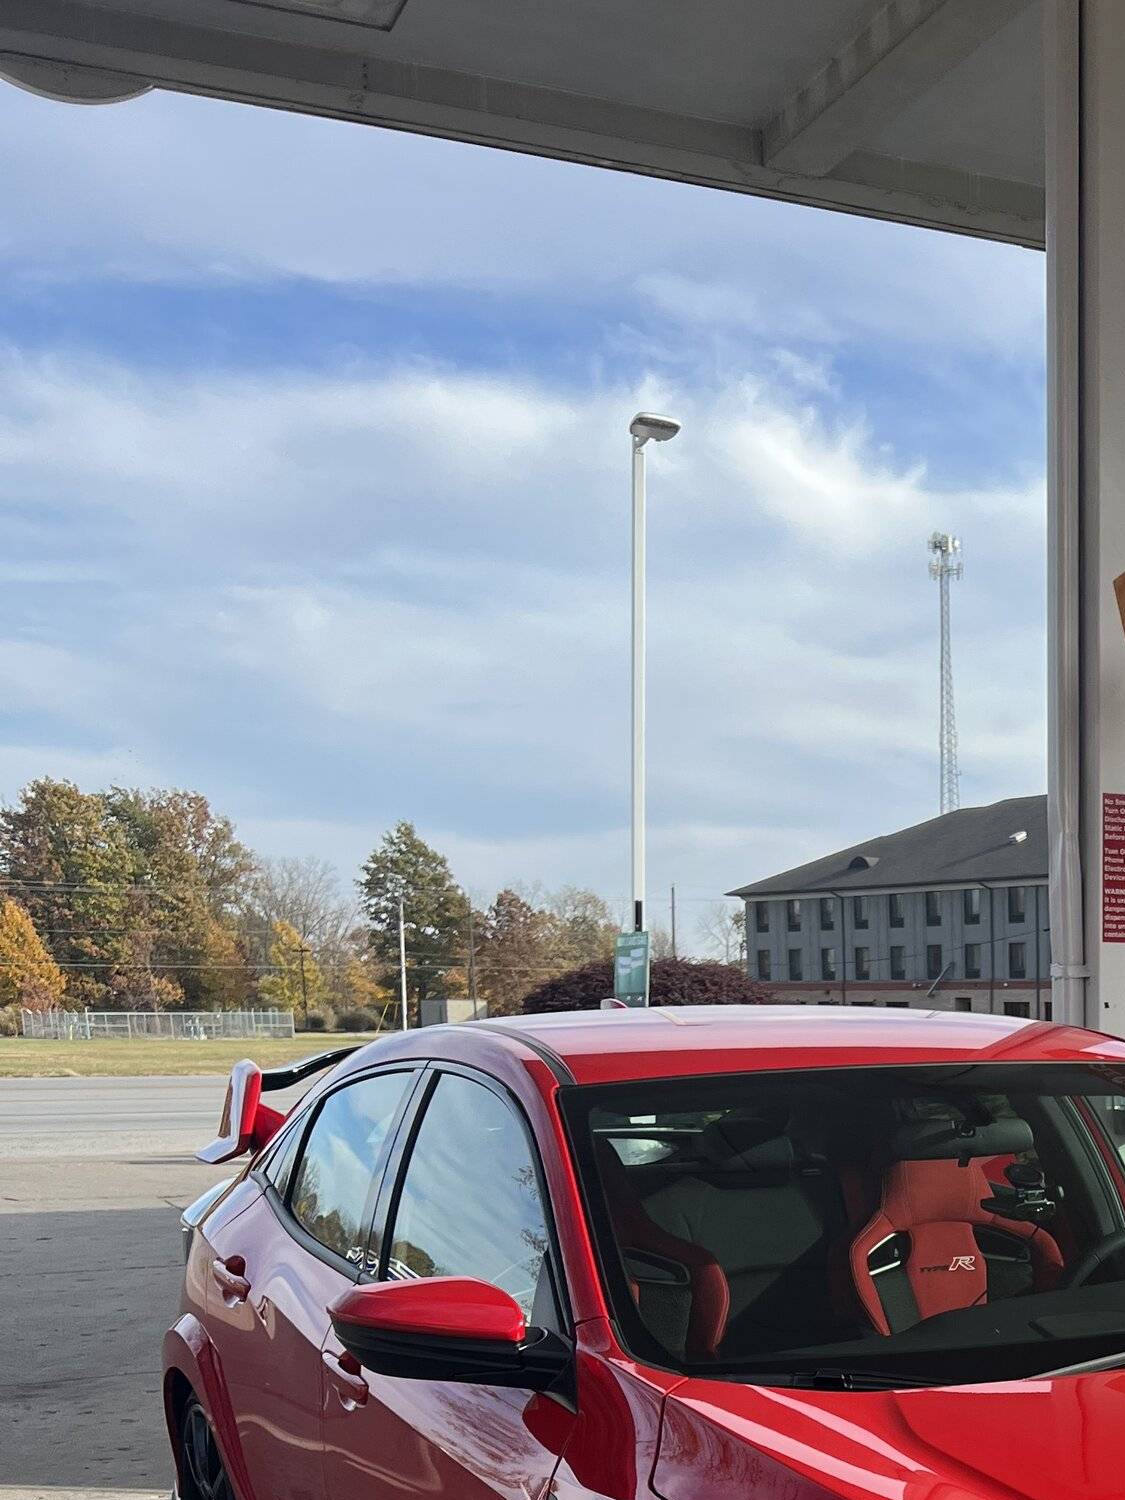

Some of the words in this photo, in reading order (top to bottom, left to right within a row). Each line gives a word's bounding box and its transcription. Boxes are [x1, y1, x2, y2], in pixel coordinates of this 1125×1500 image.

[1104, 806, 1119, 815] Turn
[1104, 833, 1125, 841] Before
[1104, 847, 1119, 855] Turn
[1104, 856, 1124, 864] Phone
[949, 1255, 976, 1271] R
